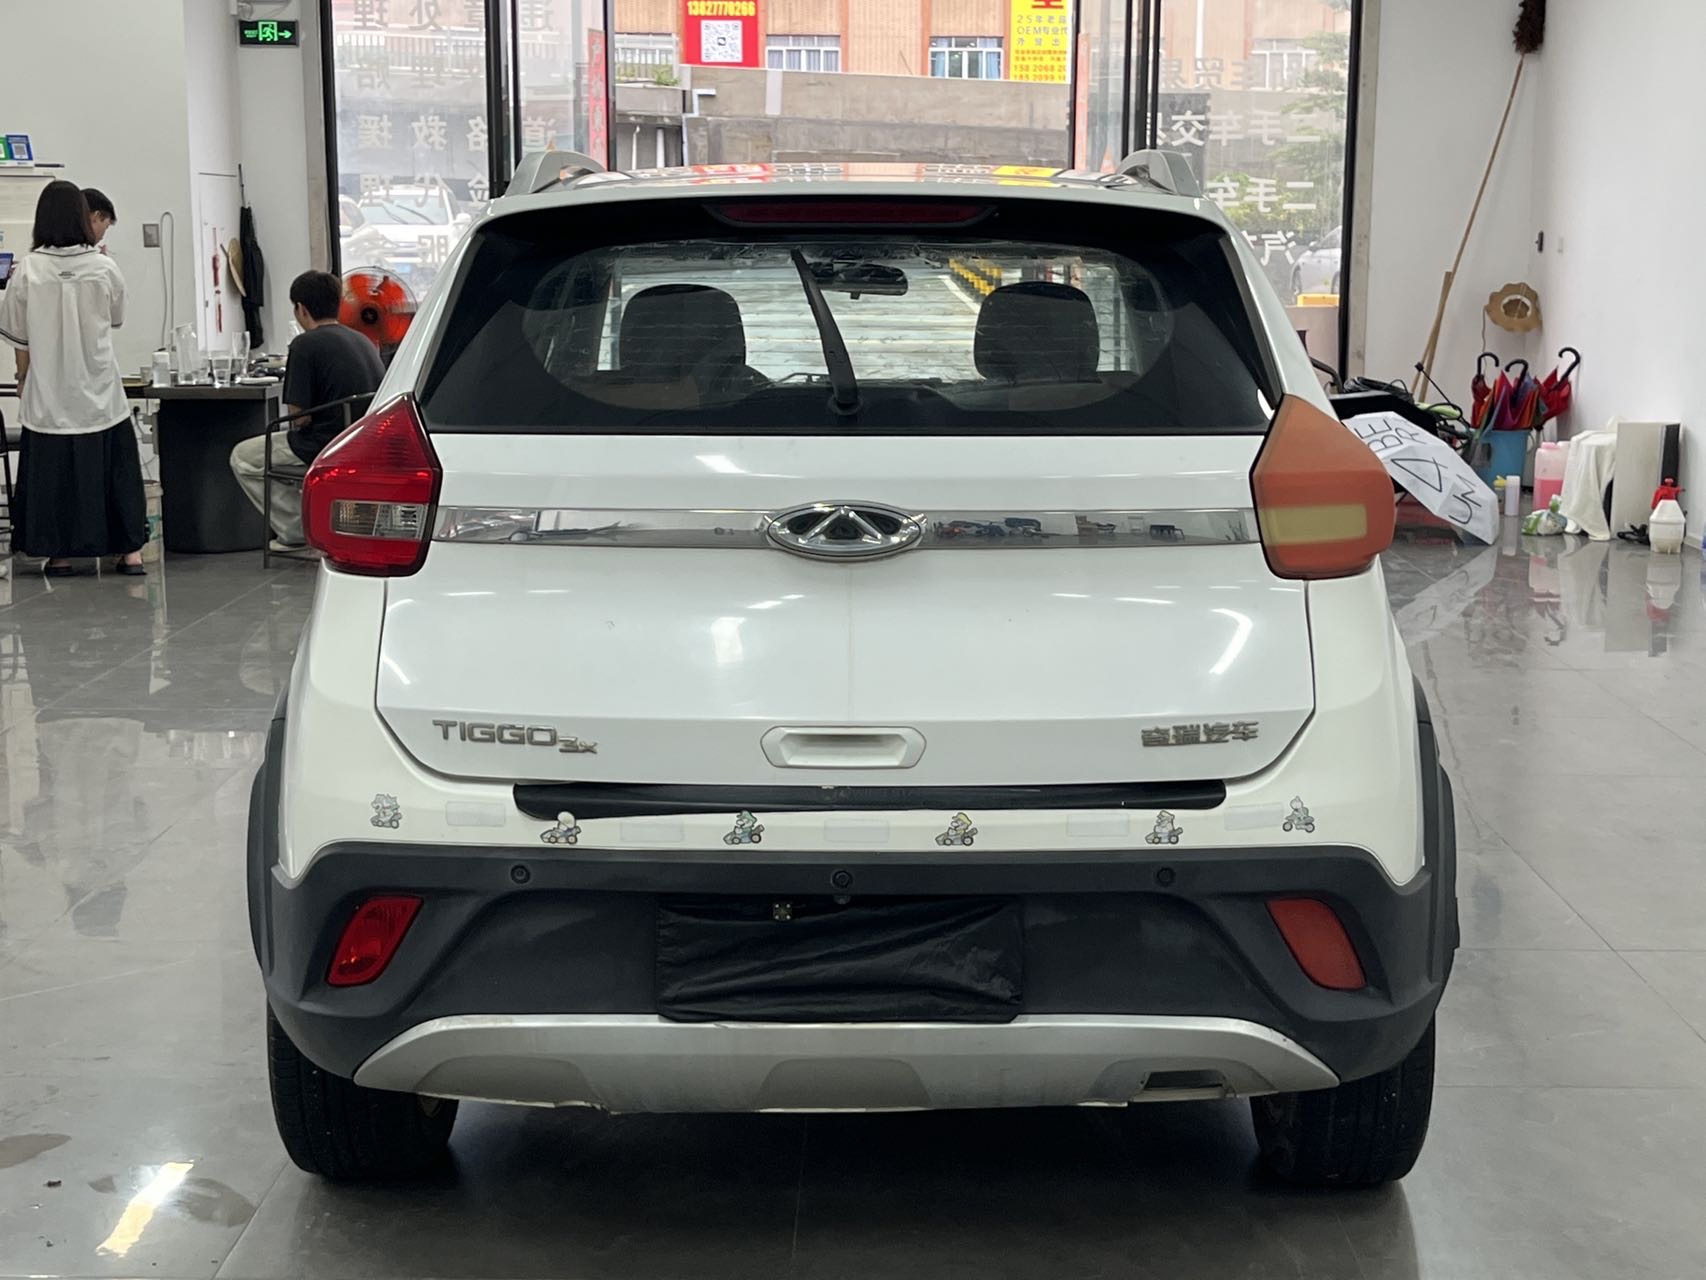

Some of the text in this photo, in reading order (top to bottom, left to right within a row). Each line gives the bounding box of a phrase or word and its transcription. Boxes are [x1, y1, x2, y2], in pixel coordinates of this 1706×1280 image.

[432, 719, 557, 746] TIGGO
[1141, 721, 1259, 747] 奇瑞汽车
